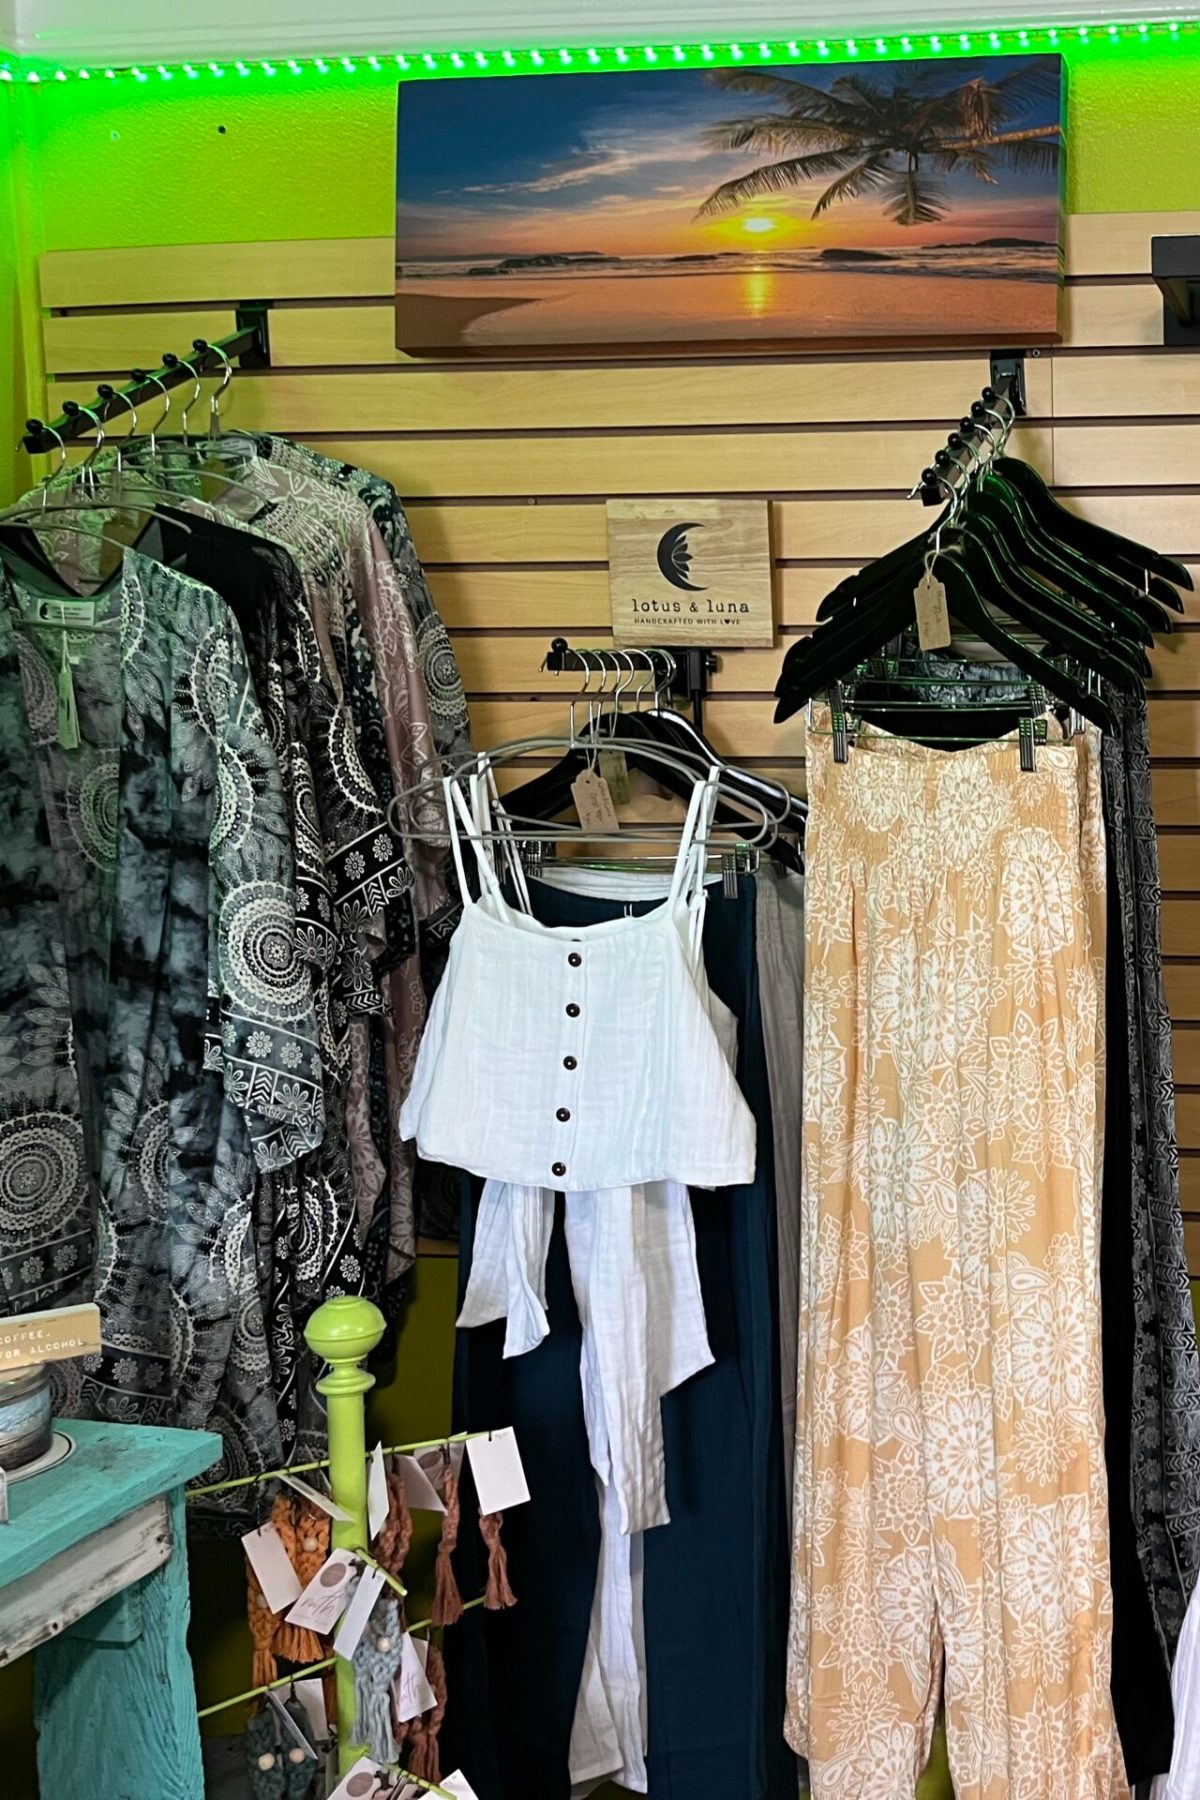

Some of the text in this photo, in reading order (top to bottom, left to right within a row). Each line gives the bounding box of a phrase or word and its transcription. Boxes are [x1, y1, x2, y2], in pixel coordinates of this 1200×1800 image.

[632, 599, 750, 613] lotus & luna
[0, 1338, 84, 1359] OR ALCOHOL
